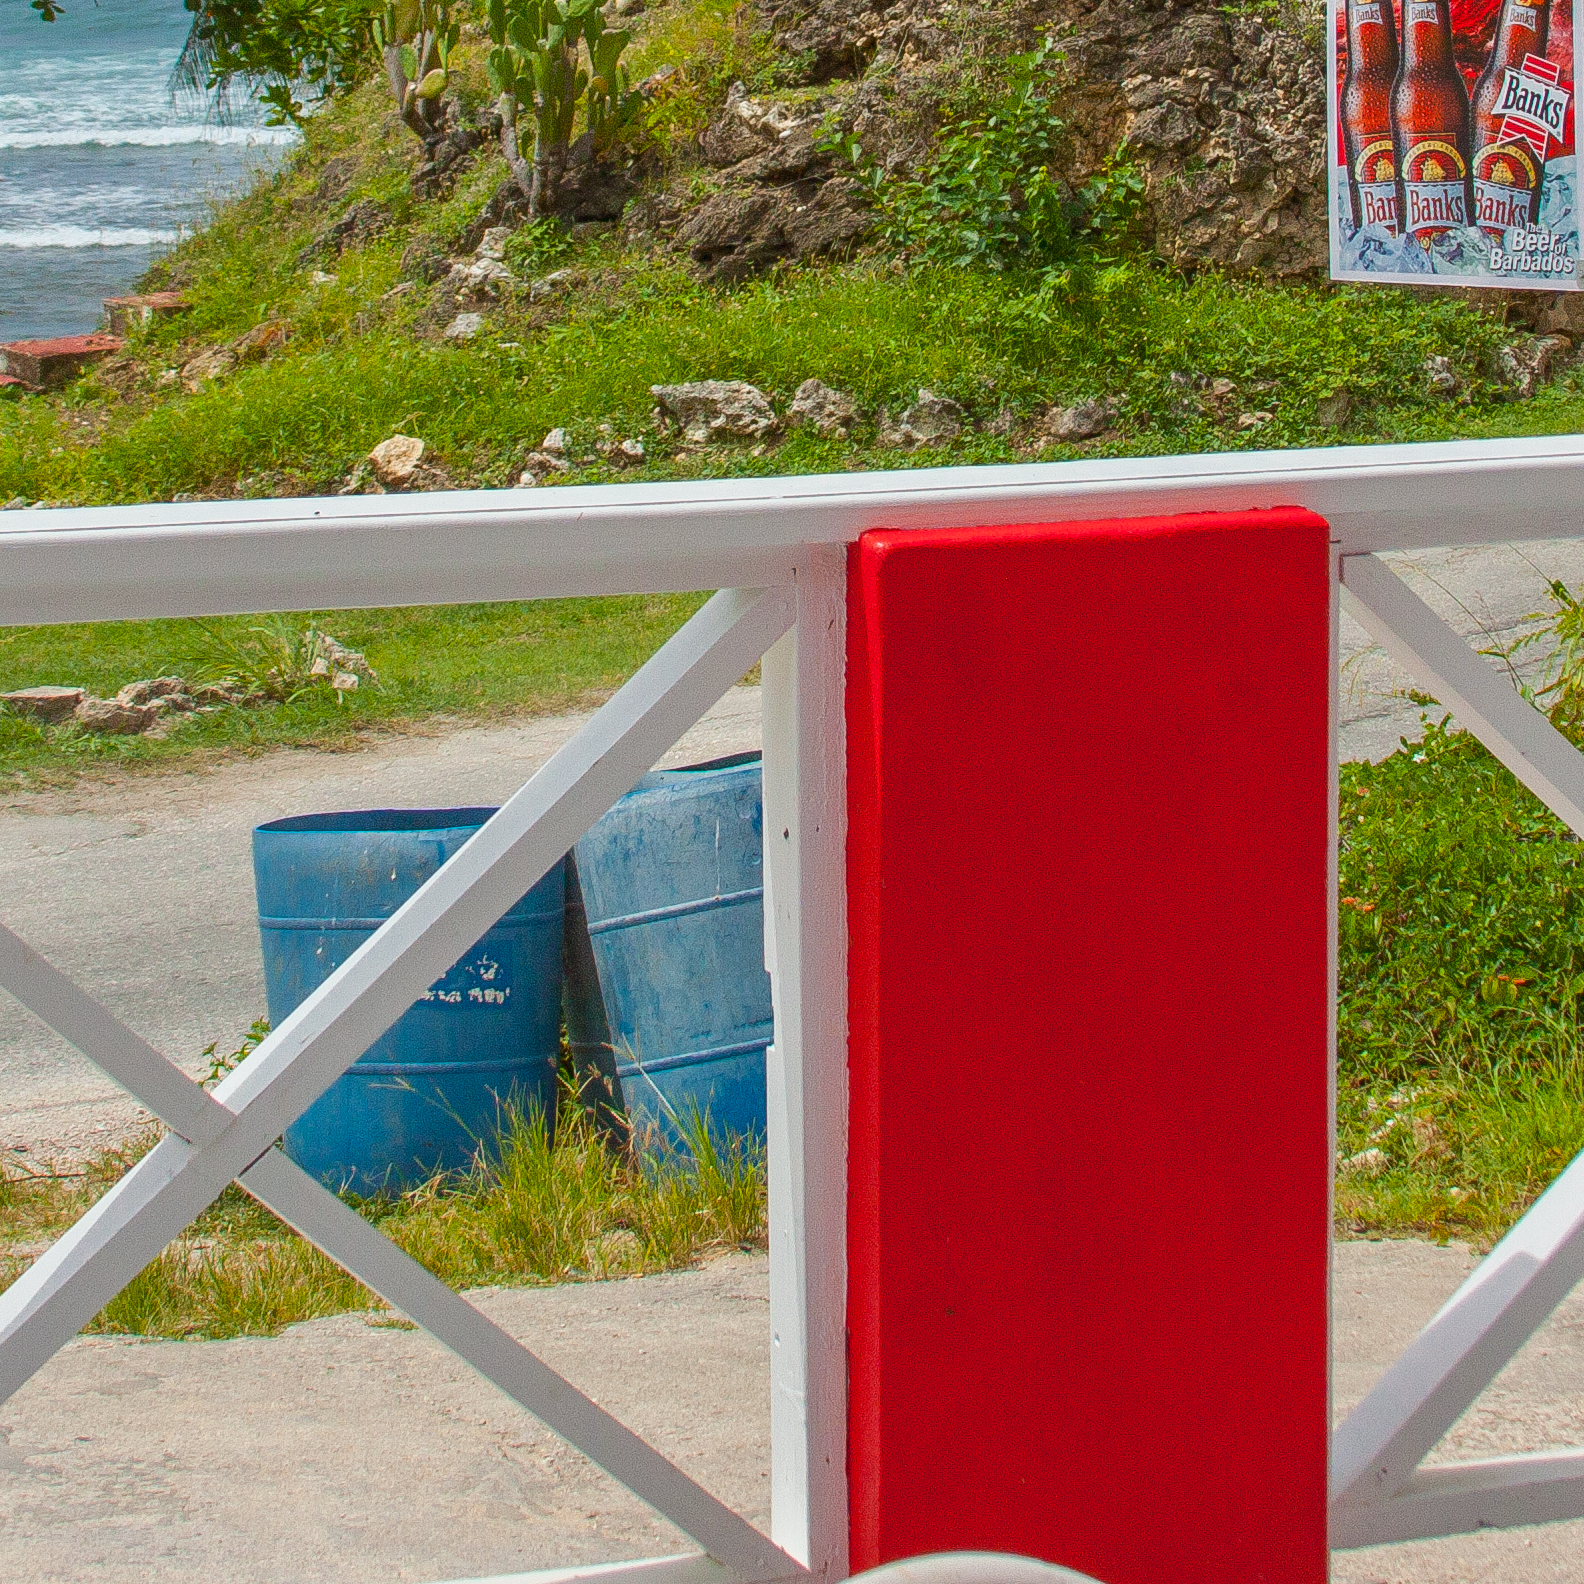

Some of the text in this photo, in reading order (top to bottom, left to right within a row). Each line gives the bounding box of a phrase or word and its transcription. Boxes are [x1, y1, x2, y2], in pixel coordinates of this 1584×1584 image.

[1356, 6, 1380, 23] Banks
[1411, 4, 1435, 21] Banks
[1509, 7, 1535, 27] Banks
[1503, 75, 1564, 130] Banks
[1410, 189, 1464, 226] Banks
[1475, 186, 1527, 230] Banks
[1526, 222, 1544, 234] The
[1512, 228, 1567, 256] Beer of
[1490, 248, 1575, 274] Barbados
